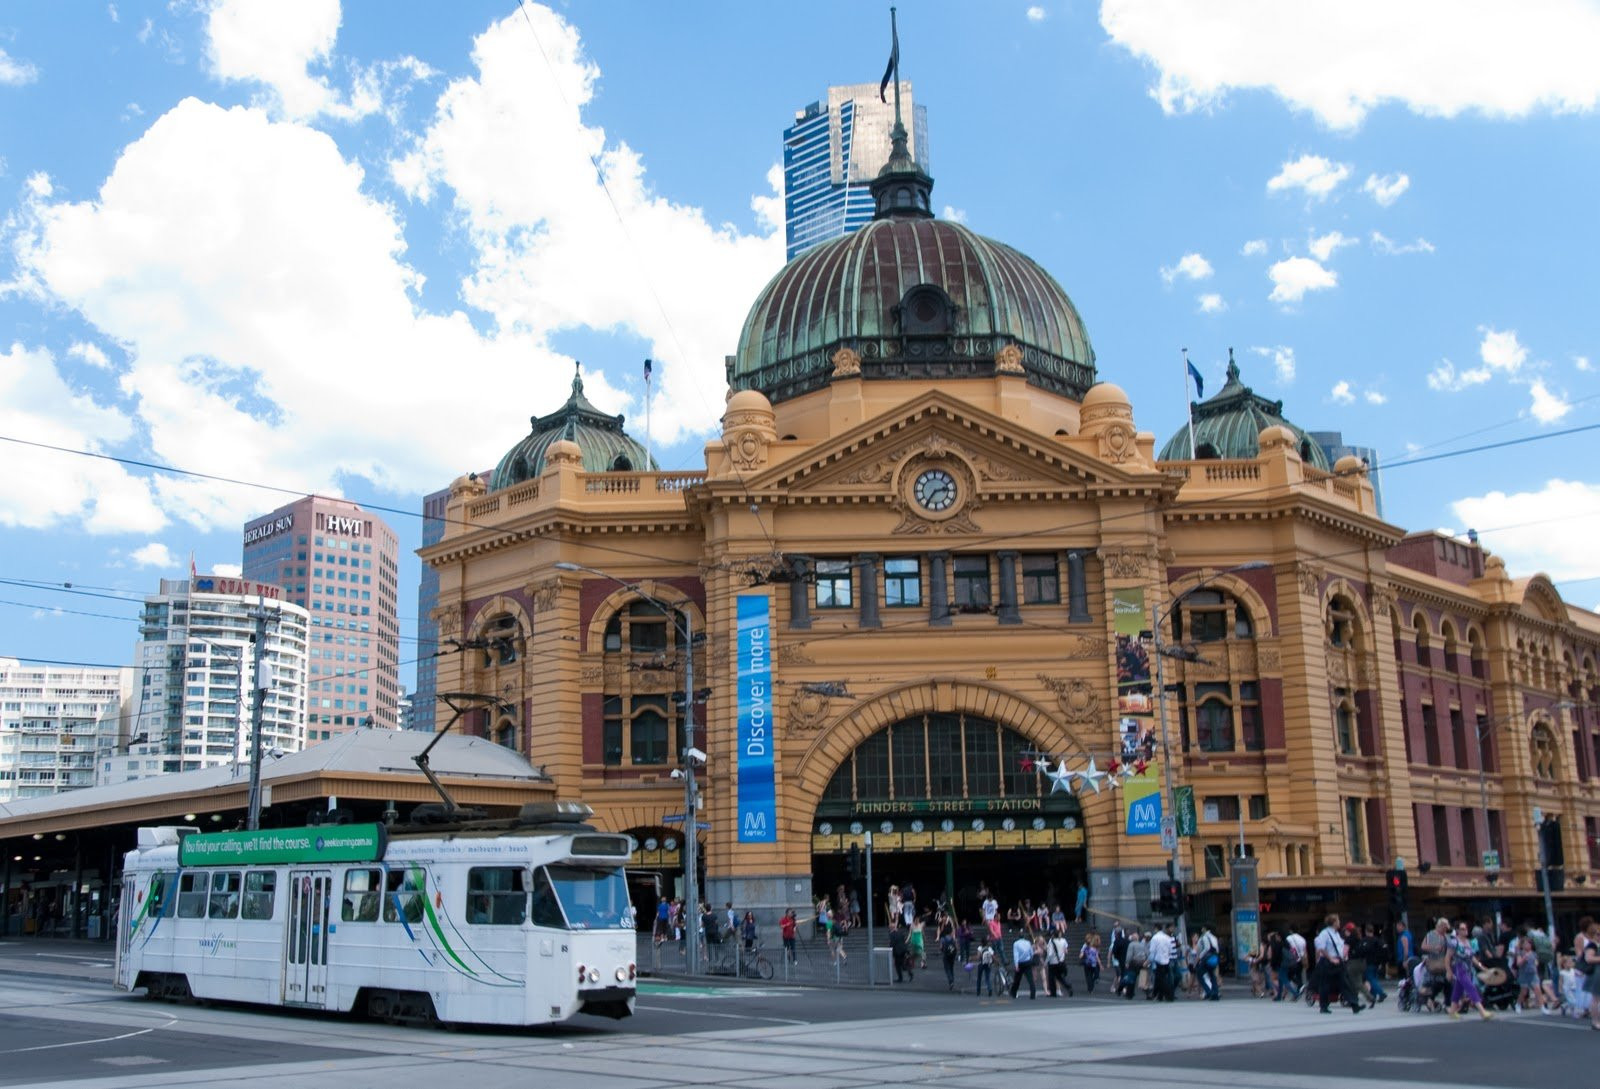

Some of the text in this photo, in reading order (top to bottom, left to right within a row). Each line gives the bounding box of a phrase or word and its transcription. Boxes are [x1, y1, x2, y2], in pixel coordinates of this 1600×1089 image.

[243, 514, 293, 544] HERALD SUN
[327, 514, 363, 534] HWT
[219, 579, 280, 600] QUAY WEST
[747, 628, 765, 756] Discover more
[855, 799, 1041, 813] FLINDERS STREET STATION
[185, 836, 311, 855] You find your calling, we'll find the course.
